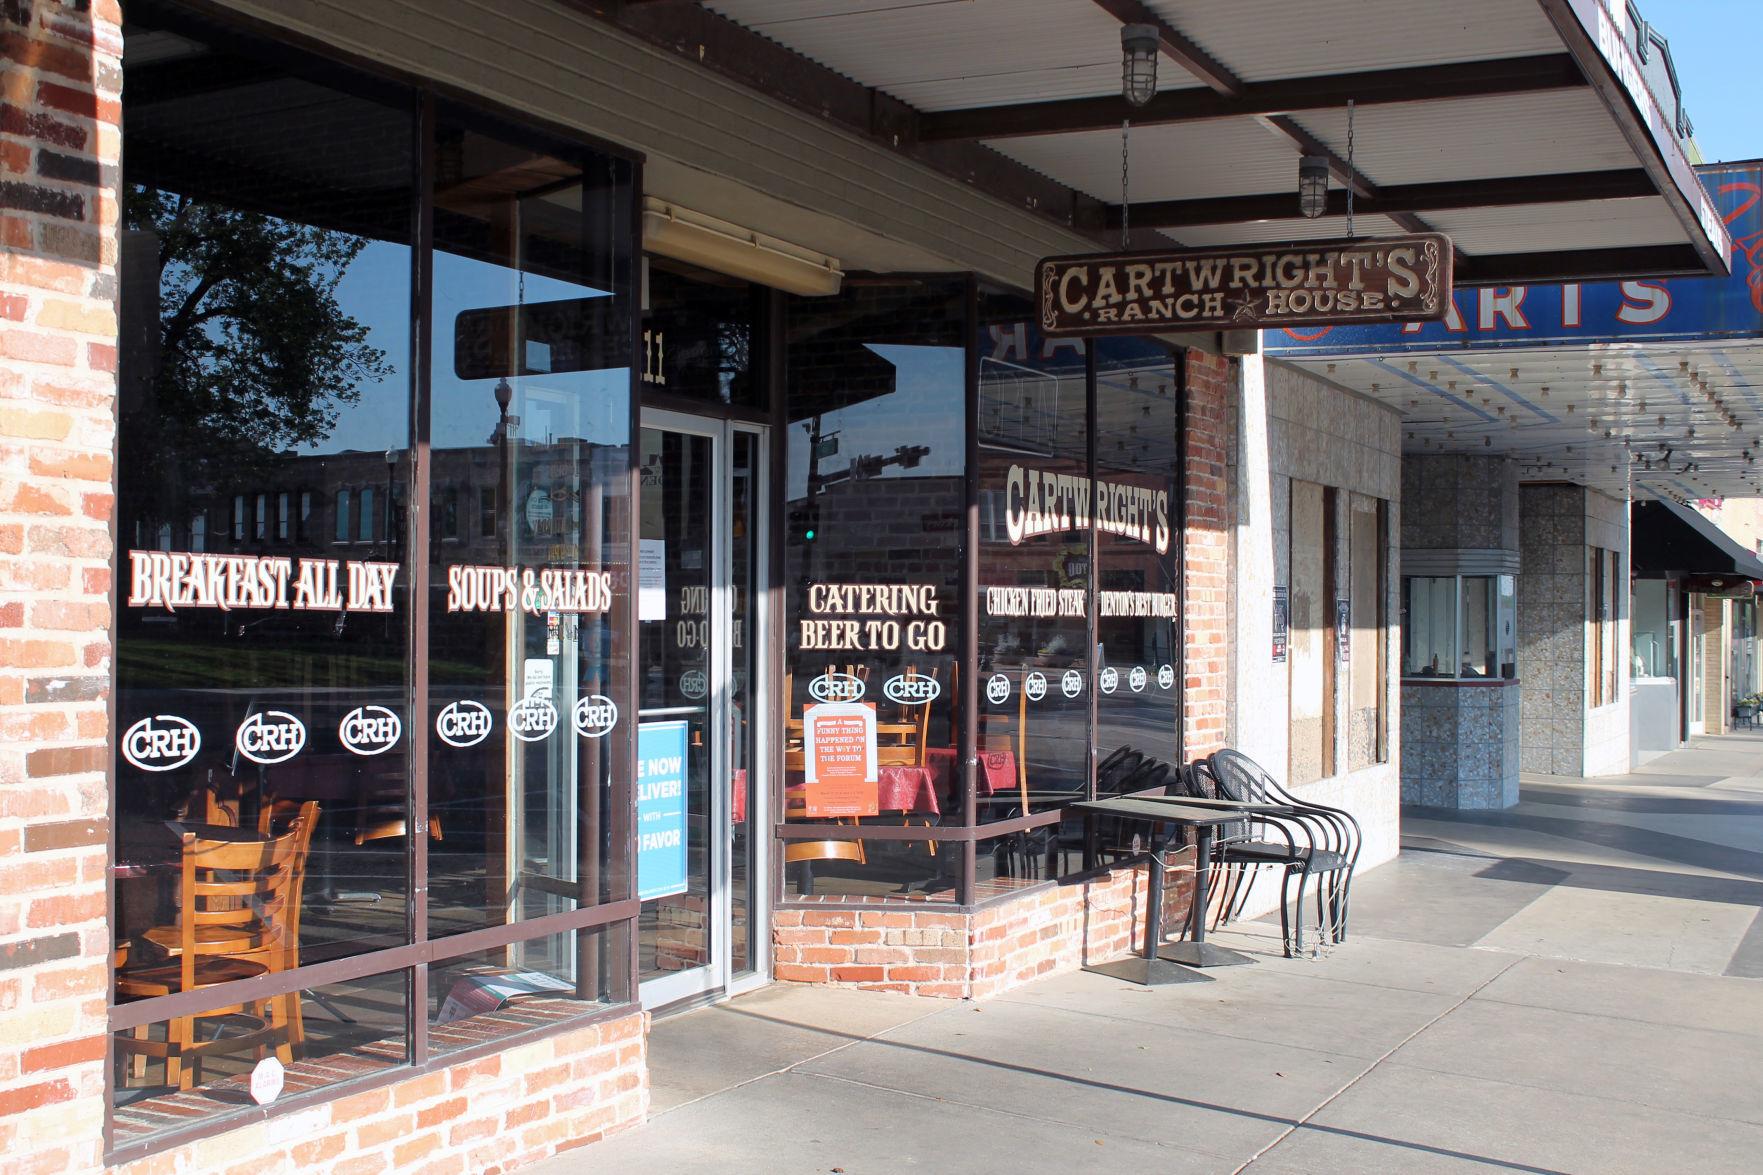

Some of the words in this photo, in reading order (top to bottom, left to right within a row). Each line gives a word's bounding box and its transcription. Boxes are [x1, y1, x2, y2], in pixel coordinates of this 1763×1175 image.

[1058, 247, 1424, 314] CARTWRIGHT'S
[1097, 292, 1225, 323] RANCH
[1006, 464, 1170, 555] CARTWRIGHT'S
[129, 549, 293, 612] BREAKFAST
[292, 558, 343, 611] ALL
[346, 560, 400, 613] DAY
[448, 565, 518, 613] SOUPS
[521, 567, 541, 617] &
[540, 567, 612, 614] SALADS
[809, 583, 940, 617] CATERING
[987, 587, 1029, 617] CHICKEN
[1030, 588, 1057, 618] FRIED
[1058, 589, 1086, 618] STEAK
[1100, 590, 1134, 617] DENTON'S
[1135, 592, 1151, 617] BEST
[1152, 593, 1178, 618] BURGER
[799, 619, 864, 650] BEER
[865, 620, 900, 650] TO
[907, 621, 946, 651] GO
[346, 708, 395, 743] CRH
[442, 702, 487, 736] CRH
[513, 700, 551, 731] CRH
[576, 697, 613, 728] CRH
[130, 717, 194, 759] CRH
[243, 712, 299, 751] CRH
[816, 736, 854, 744] HAPPENED
[648, 756, 682, 776] NOW
[643, 812, 661, 822] WITH
[643, 829, 681, 851] FAVOR
